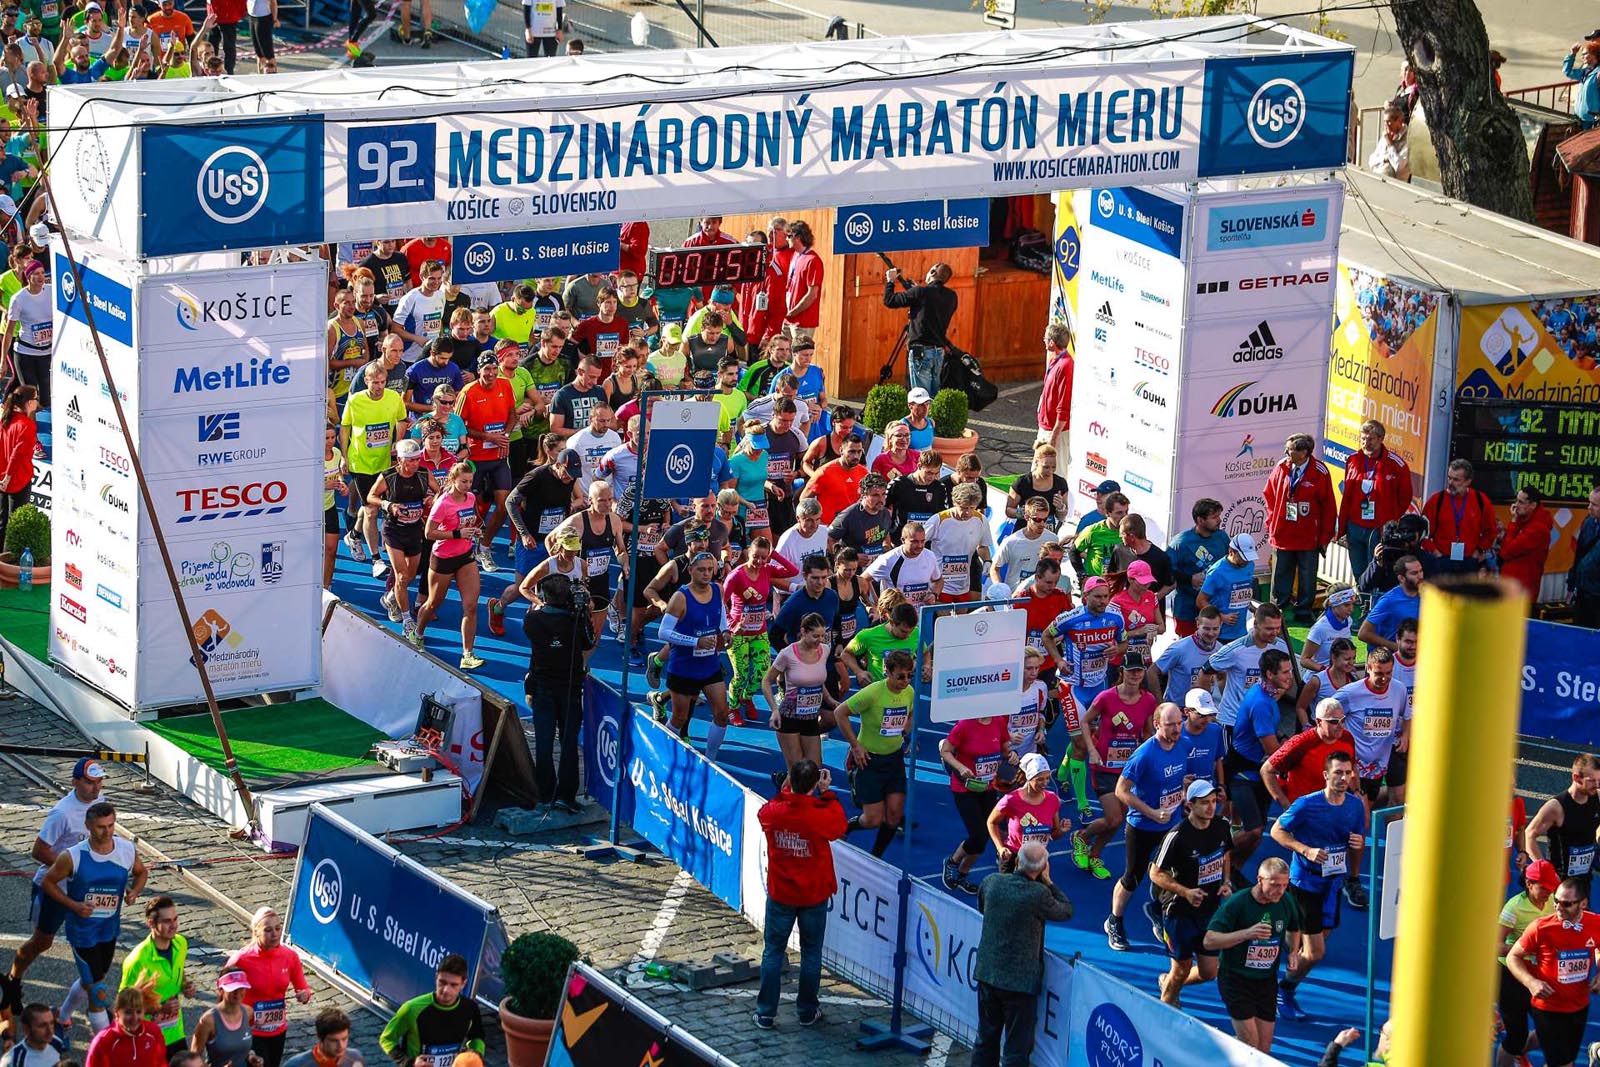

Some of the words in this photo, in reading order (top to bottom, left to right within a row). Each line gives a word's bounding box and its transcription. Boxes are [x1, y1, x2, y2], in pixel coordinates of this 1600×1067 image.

[448, 94, 812, 188] MEDZINÁRODNÝ
[831, 83, 1039, 162] MARATÓN
[1057, 85, 1184, 148] MIERU
[358, 141, 425, 192] 92.
[993, 150, 1180, 182] WWW.KOSICEMARATHON.COM
[447, 196, 500, 221] KOŠICE
[532, 190, 617, 215] SLOVENSKO
[882, 219, 894, 233] U.
[898, 219, 910, 232] S.
[913, 217, 940, 231] Steel
[944, 215, 979, 230] Košice
[1136, 210, 1152, 227] Steel
[1153, 218, 1175, 235] Košice
[1221, 212, 1299, 234] SLOVENSKÁ
[505, 248, 517, 262] U.
[522, 247, 534, 260] S.
[538, 242, 568, 259] Steel
[572, 241, 610, 257] Košice
[1091, 270, 1124, 293] MetLife
[1239, 271, 1329, 291] GETRAG
[203, 292, 293, 323] KOŠICE
[1135, 346, 1170, 370] TESCO
[1233, 345, 1283, 363] adidas
[60, 360, 88, 386] MetLife
[174, 357, 291, 393] MetLife
[422, 377, 446, 385] CRAFT
[1329, 348, 1419, 405] Medzinárodný
[1238, 391, 1298, 416] DÚHA
[1380, 403, 1421, 438] mieru
[1520, 409, 1546, 434] 92.
[374, 430, 390, 441] 5223
[99, 446, 130, 473] TESCO
[1225, 460, 1252, 472] Košice
[1252, 458, 1275, 469] 2016
[1485, 441, 1536, 462] KOSICE
[1560, 445, 1600, 466] SLOV
[176, 481, 288, 512] TESCO
[181, 560, 214, 576] Pijeme
[950, 565, 967, 573] 3466
[217, 574, 256, 590] vodovodu
[1075, 629, 1116, 643] Tinkoff
[209, 647, 260, 663] Medzinárodný
[946, 673, 1000, 688] SLOVENSKÁ
[1556, 671, 1600, 703] Ste
[1064, 694, 1080, 728] Tinkoff
[662, 782, 691, 824] Steel
[691, 806, 733, 857] Košice
[95, 896, 117, 908] 3475
[836, 877, 889, 943] ICE
[350, 893, 362, 925] U.
[367, 905, 379, 936] S.
[383, 916, 418, 957] Steel
[1257, 946, 1277, 959] 4303
[1568, 961, 1588, 973] 3686
[265, 1009, 283, 1022] 2388
[1096, 1015, 1142, 1062] MODRÝ
